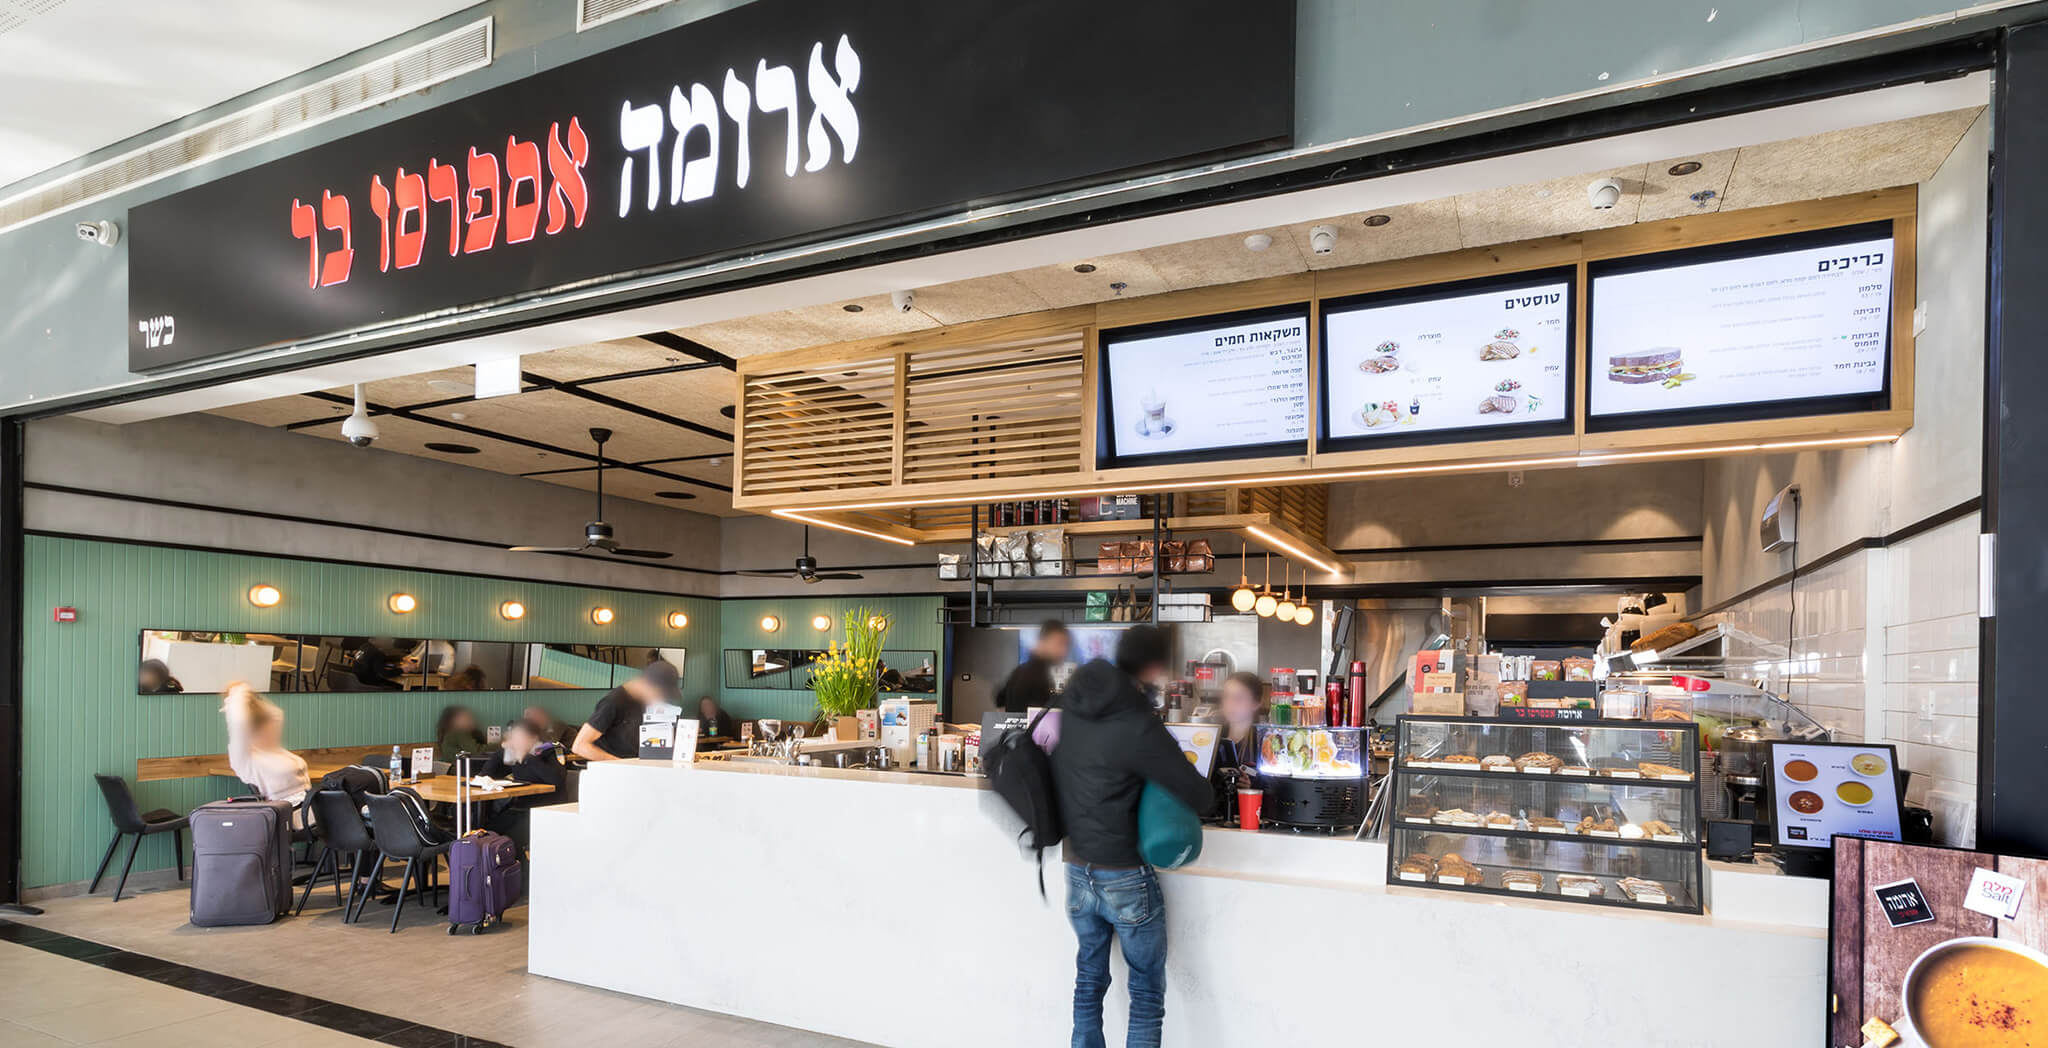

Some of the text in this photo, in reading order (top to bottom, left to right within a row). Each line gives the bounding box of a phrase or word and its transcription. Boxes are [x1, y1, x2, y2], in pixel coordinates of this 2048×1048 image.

[291, 34, 861, 289] ארומה אספרסו בר
[1818, 253, 1883, 272] כריכים
[1858, 283, 1882, 293] סלמון
[1505, 293, 1560, 310] טוסטים
[1853, 307, 1881, 315] חביתה
[139, 314, 175, 349] כשר
[1214, 327, 1301, 347] משקאות חמים
[1557, 709, 1582, 720] ארומה
[1981, 887, 2009, 904] Salt
[1983, 880, 2013, 896] מלח
[1885, 891, 1919, 911] ארומה
